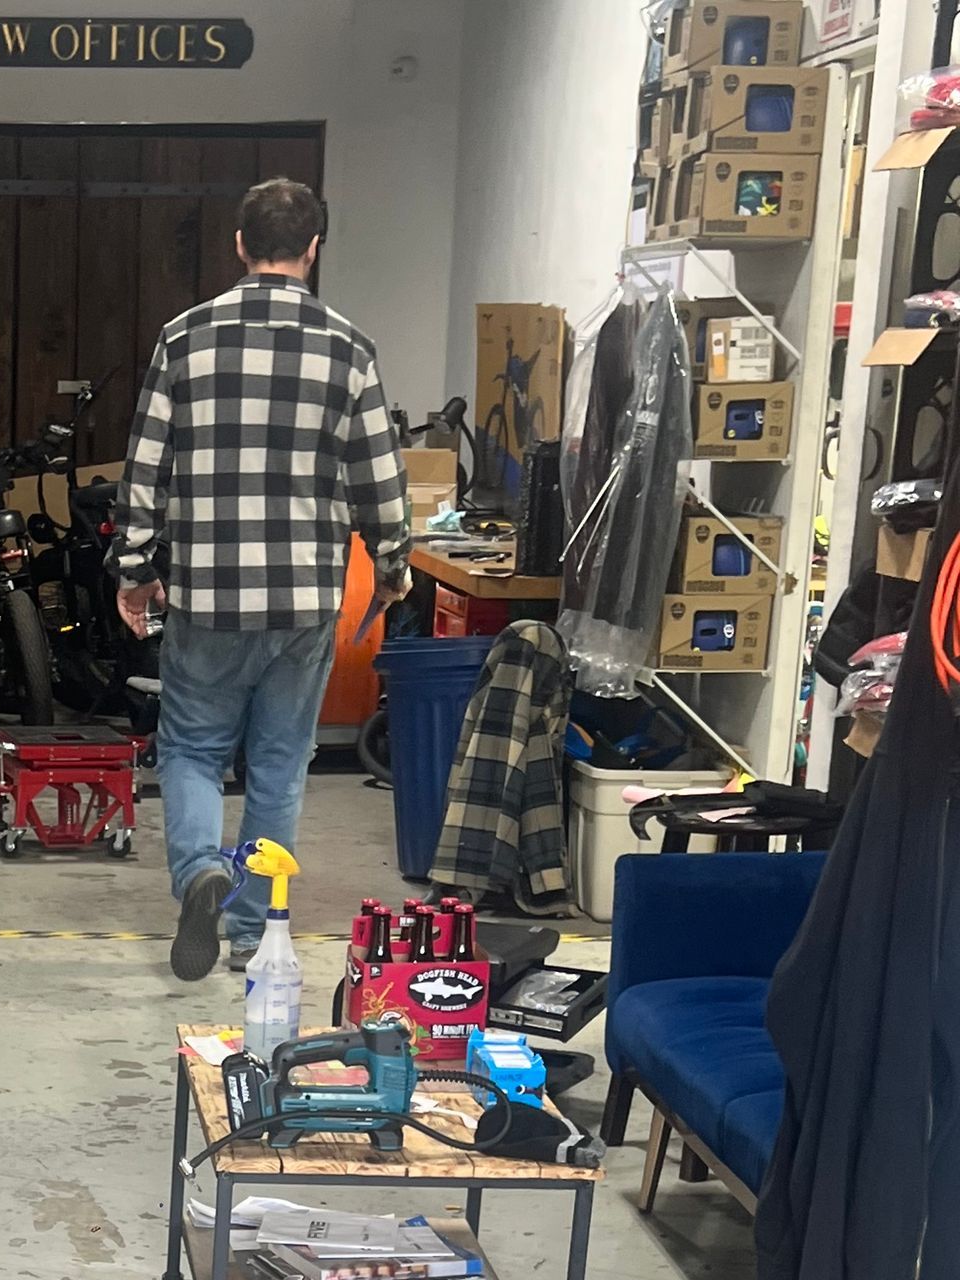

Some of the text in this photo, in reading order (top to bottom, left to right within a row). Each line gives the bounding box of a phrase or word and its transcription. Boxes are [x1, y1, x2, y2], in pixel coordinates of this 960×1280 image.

[50, 22, 226, 62] OFFICES
[416, 968, 480, 987] DOGFISH HEAD
[432, 1023, 443, 1036] 90
